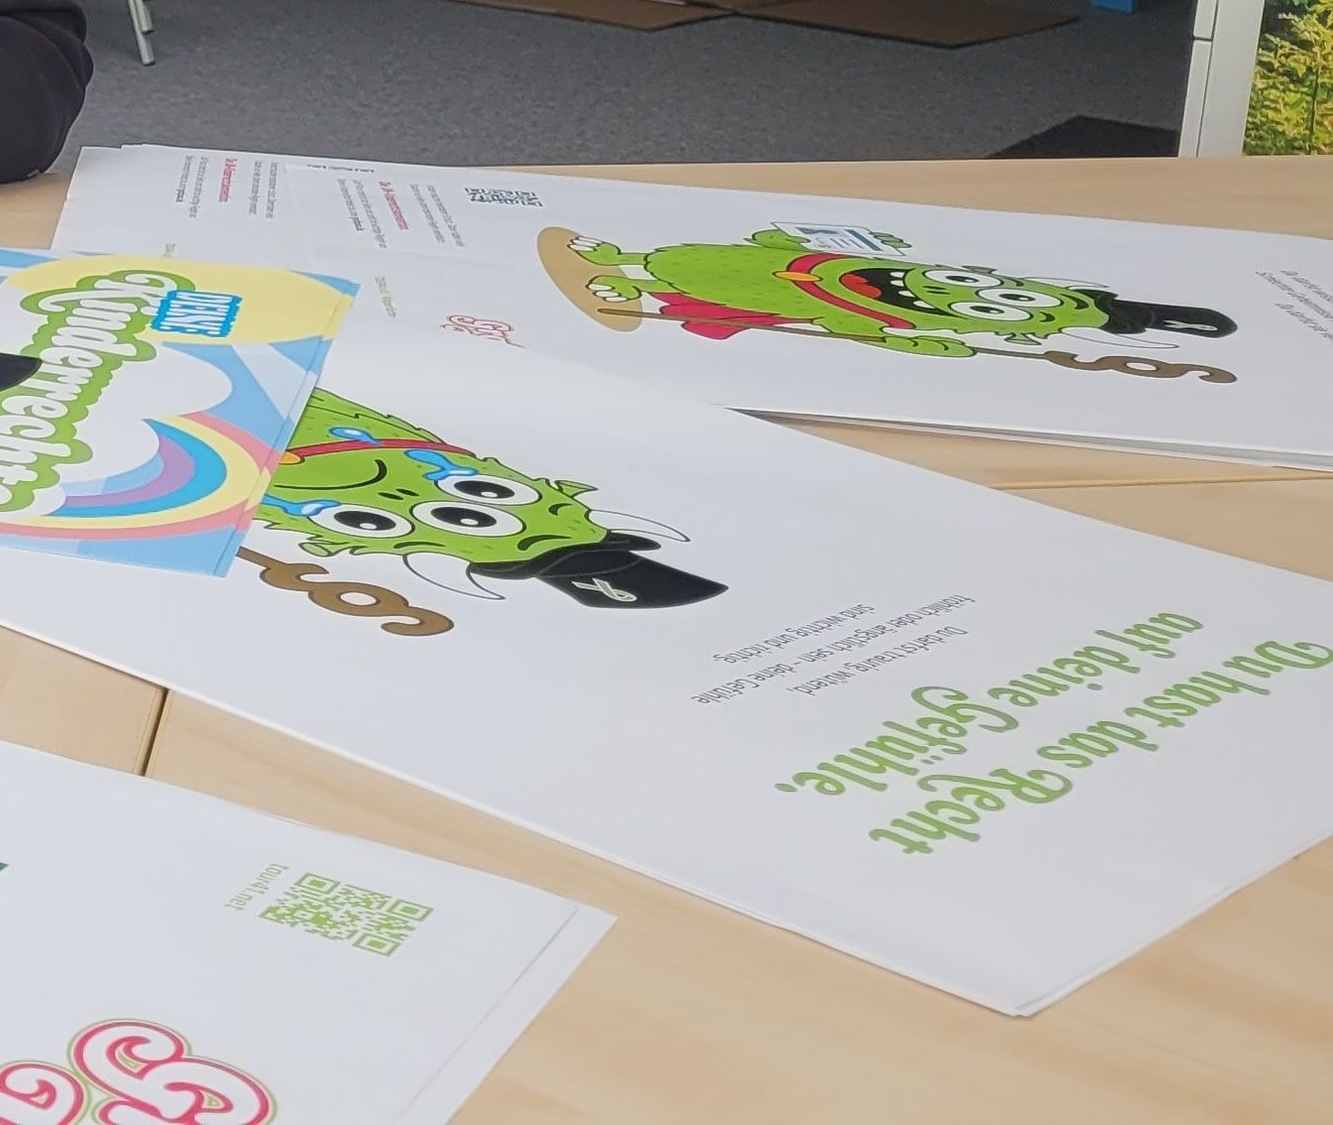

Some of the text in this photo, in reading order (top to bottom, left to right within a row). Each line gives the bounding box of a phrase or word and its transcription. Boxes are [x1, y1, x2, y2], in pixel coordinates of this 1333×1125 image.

[161, 292, 233, 336] DEINE
[885, 613, 924, 628] oder
[913, 594, 976, 617] fröhlich
[712, 603, 875, 664] sind wichtig und richtig.
[826, 624, 899, 652] ängstlich
[746, 662, 797, 682] deine
[785, 625, 969, 697] Du darfst traurig, wütend,
[796, 648, 835, 663] sein
[690, 678, 761, 704] Gefühle
[774, 612, 1204, 796] auf deine Gefühle.
[868, 640, 1333, 855] Du hast das Recht
[223, 863, 291, 911] tour41.net
